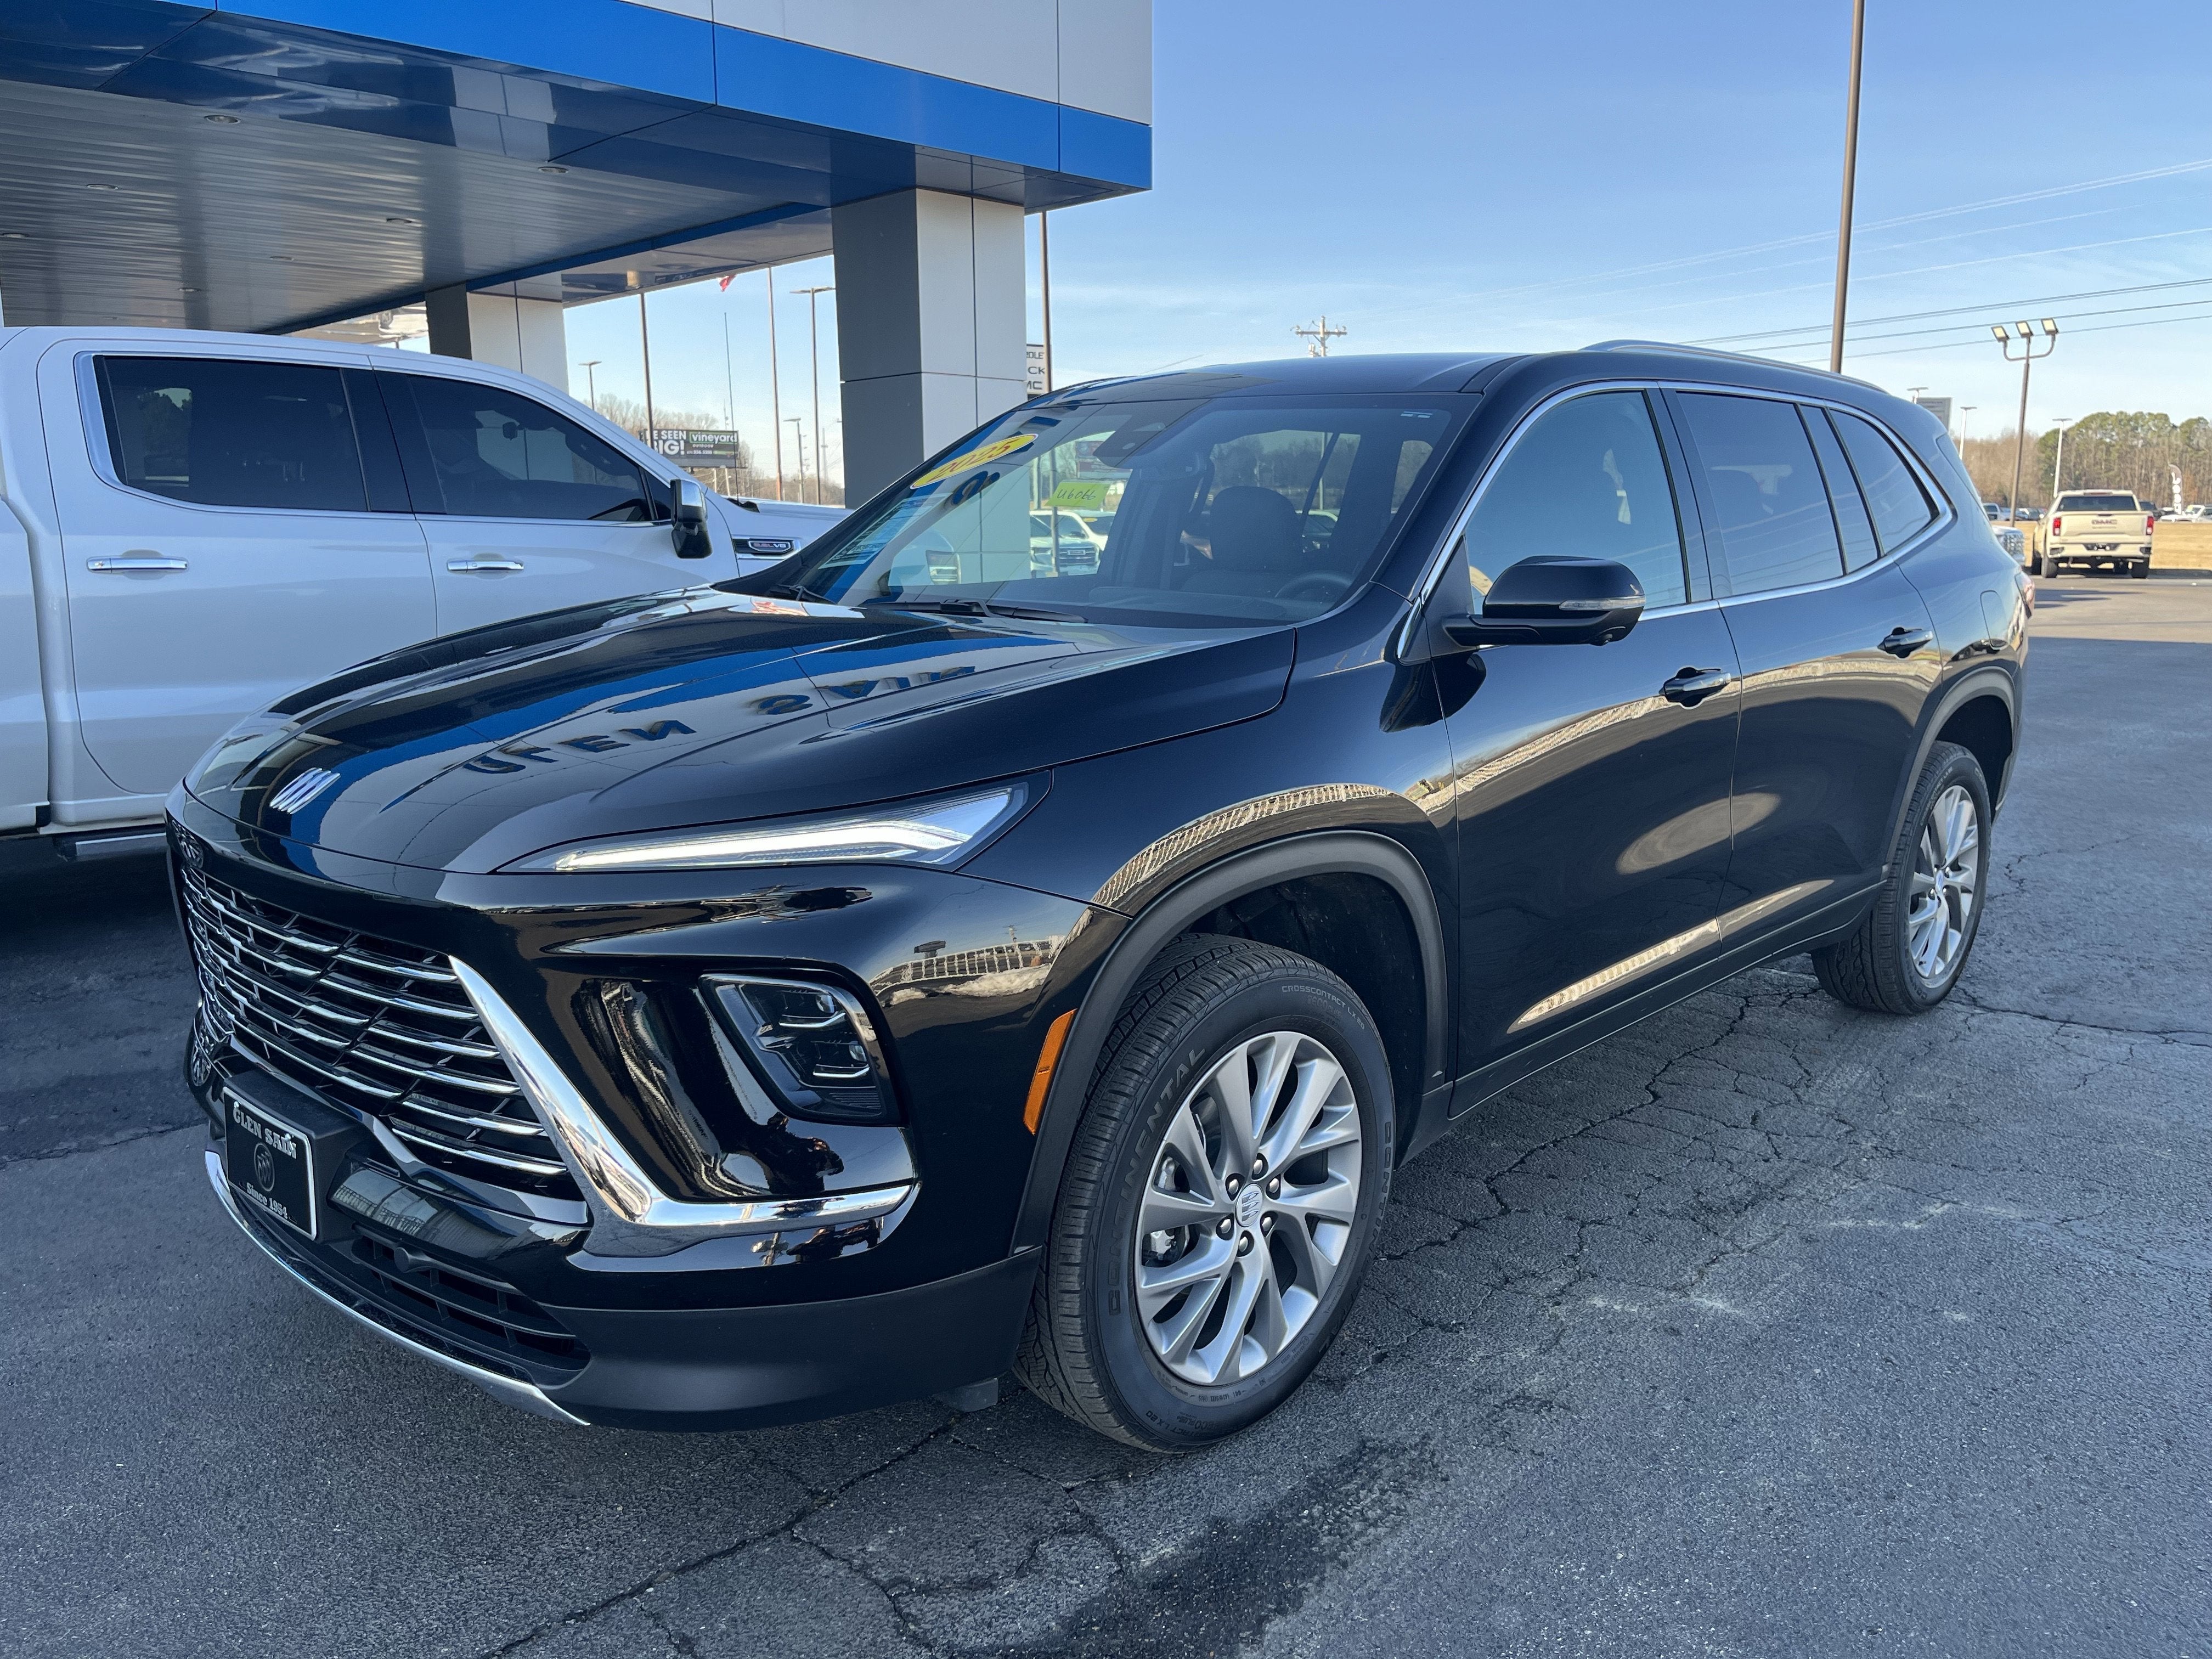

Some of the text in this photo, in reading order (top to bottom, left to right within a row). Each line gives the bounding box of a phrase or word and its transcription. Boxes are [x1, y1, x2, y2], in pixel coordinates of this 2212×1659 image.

[661, 430, 686, 441] SEEN
[692, 431, 737, 444] vineyard
[927, 439, 1019, 483] 2025
[1281, 985, 1346, 1007] CROSSCONTACT
[233, 1107, 297, 1159] GLEN SAIN
[1107, 1047, 1206, 1316] CONTINENTAL
[247, 1182, 288, 1220] Since 1954
